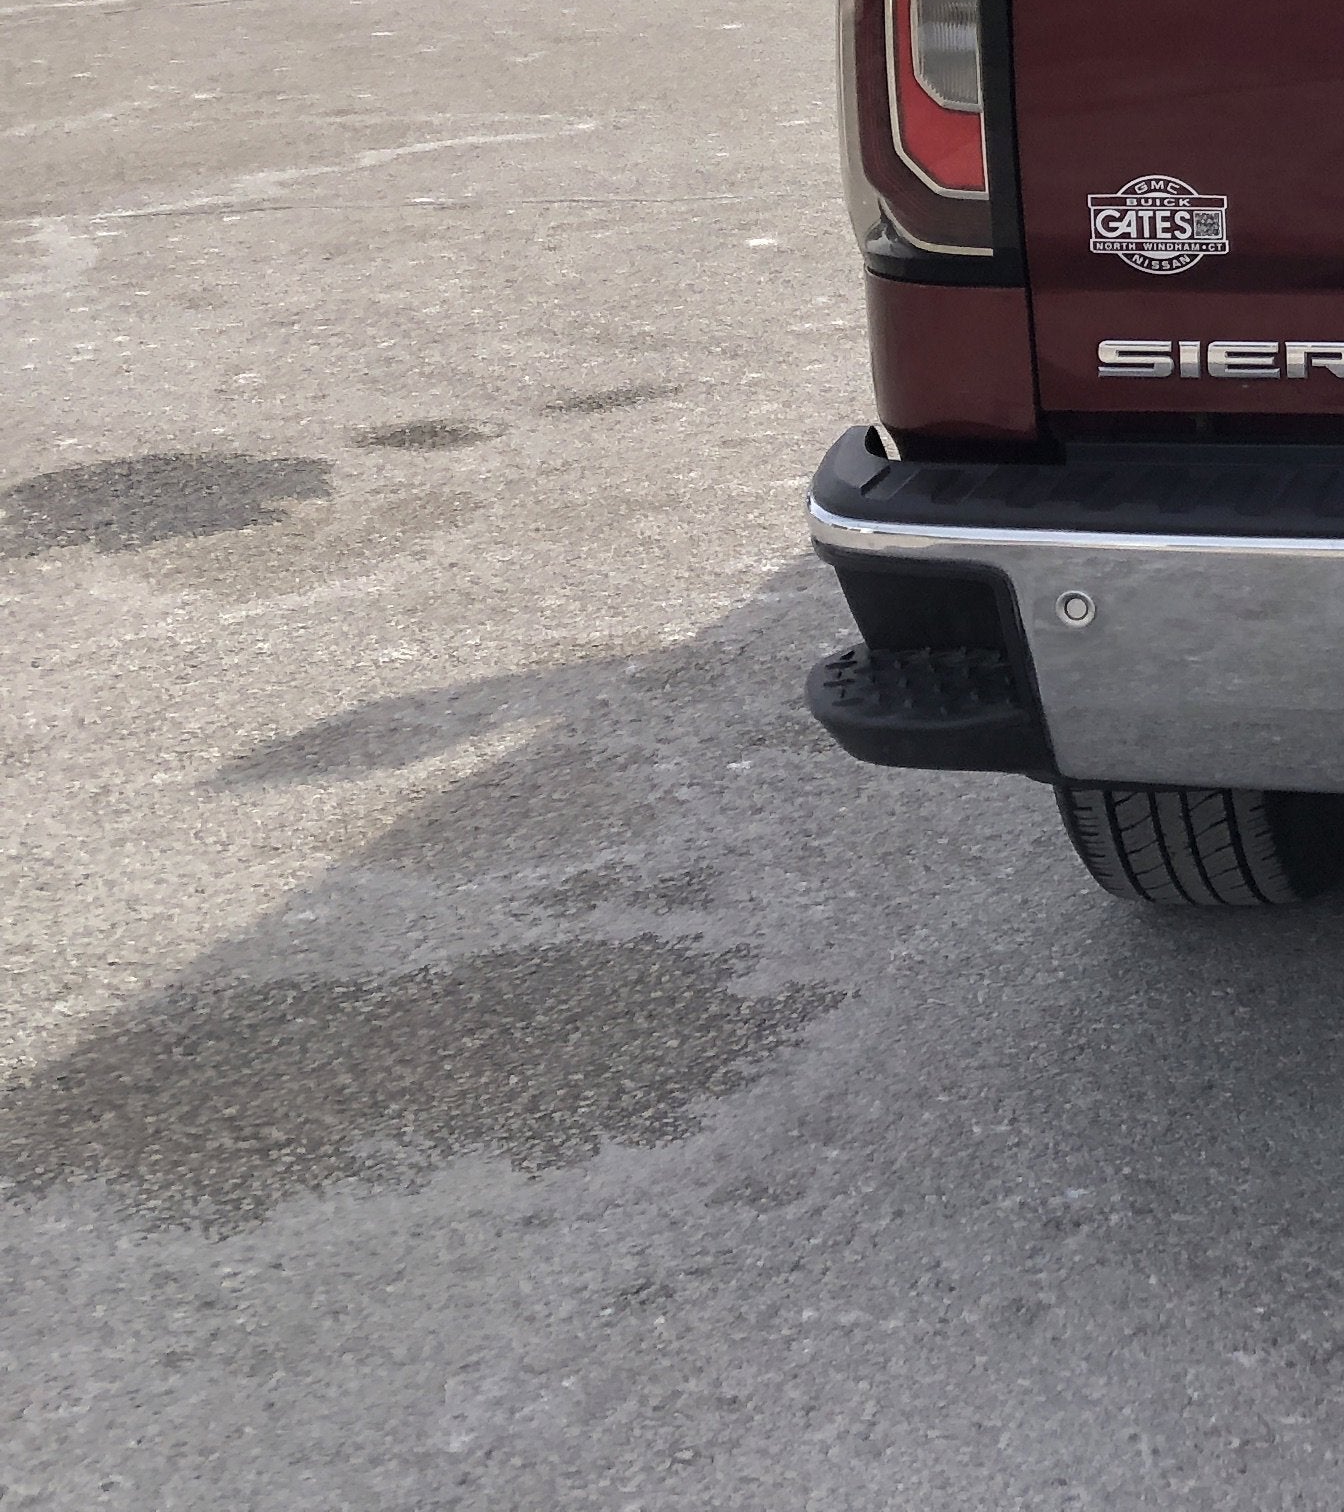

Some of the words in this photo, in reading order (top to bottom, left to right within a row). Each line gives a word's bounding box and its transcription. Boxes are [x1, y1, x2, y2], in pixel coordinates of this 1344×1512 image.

[1134, 180, 1180, 194] GMC
[1126, 197, 1191, 207] BUICK
[1095, 209, 1192, 239] GATES
[1096, 241, 1137, 251] NORTH
[1132, 254, 1191, 270] NISSAN
